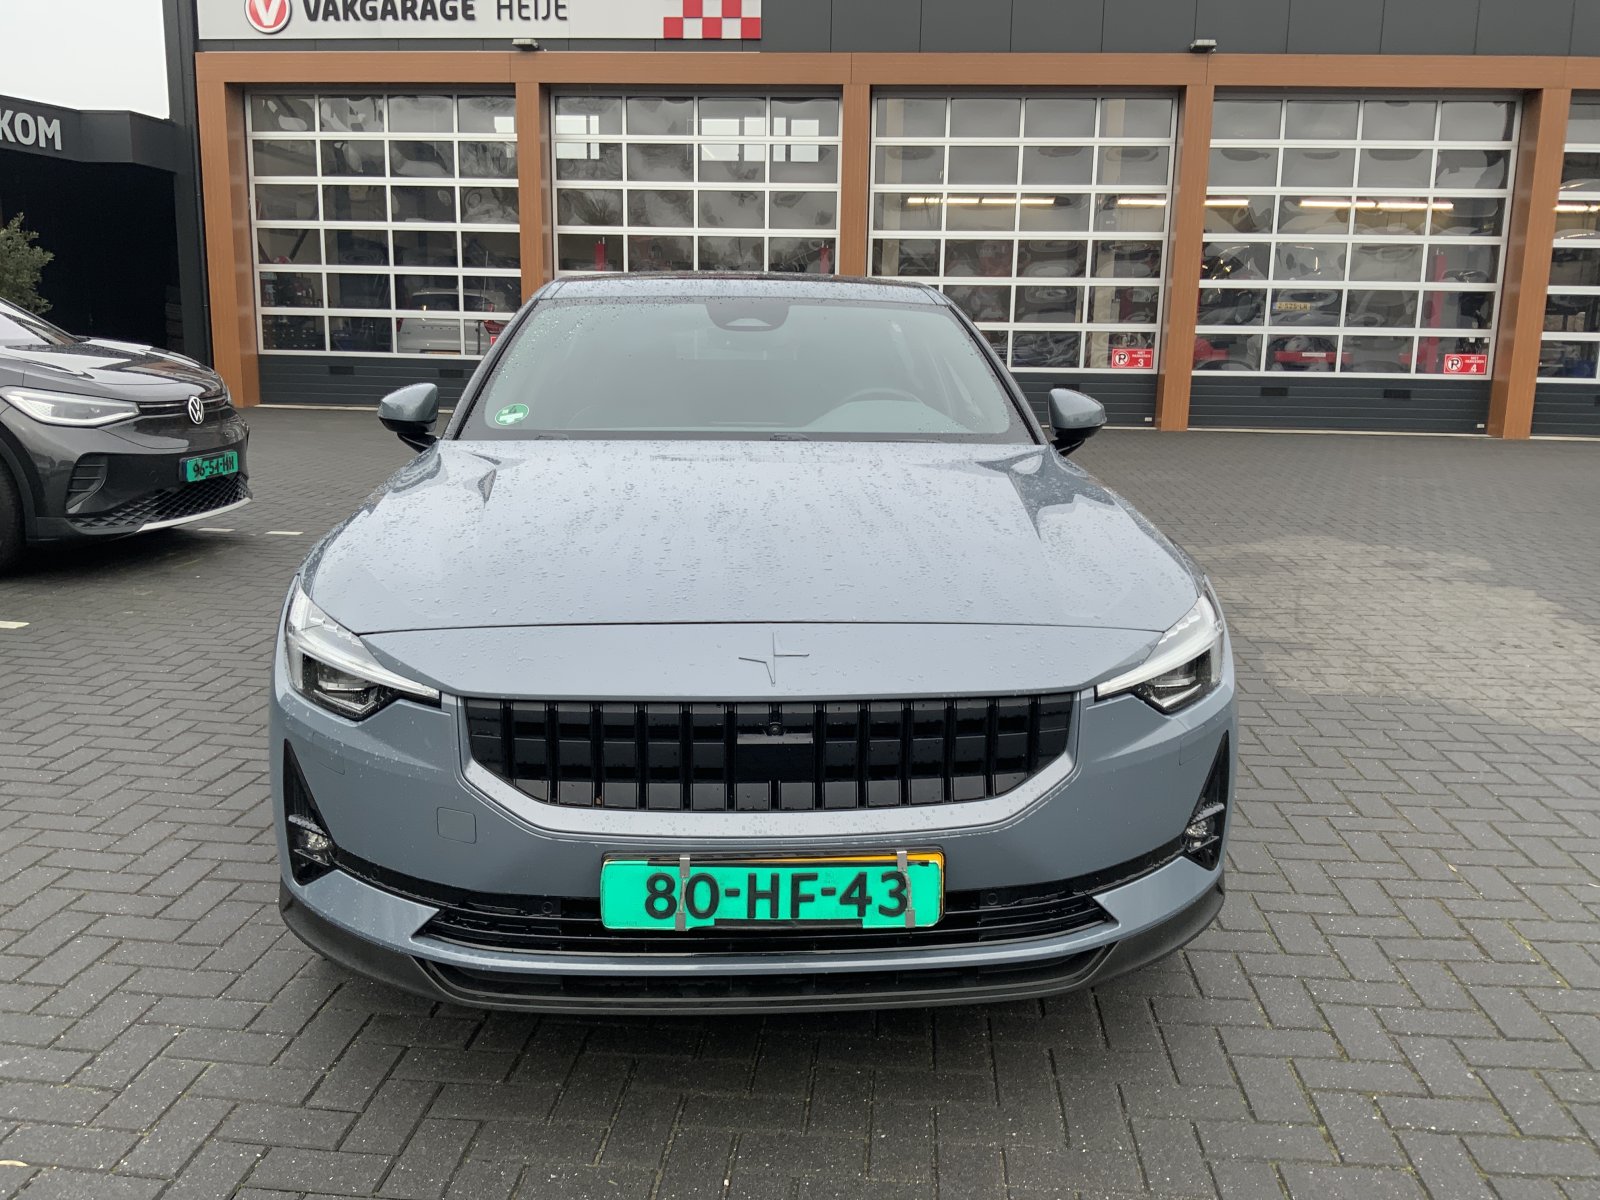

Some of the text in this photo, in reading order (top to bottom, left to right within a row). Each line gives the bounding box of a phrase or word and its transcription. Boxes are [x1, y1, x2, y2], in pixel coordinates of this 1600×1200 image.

[303, 0, 568, 21] VAKGARAGE HEIJE
[1138, 359, 1144, 367] 3
[1471, 364, 1478, 373] 4
[644, 871, 909, 919] 80-HF-43
